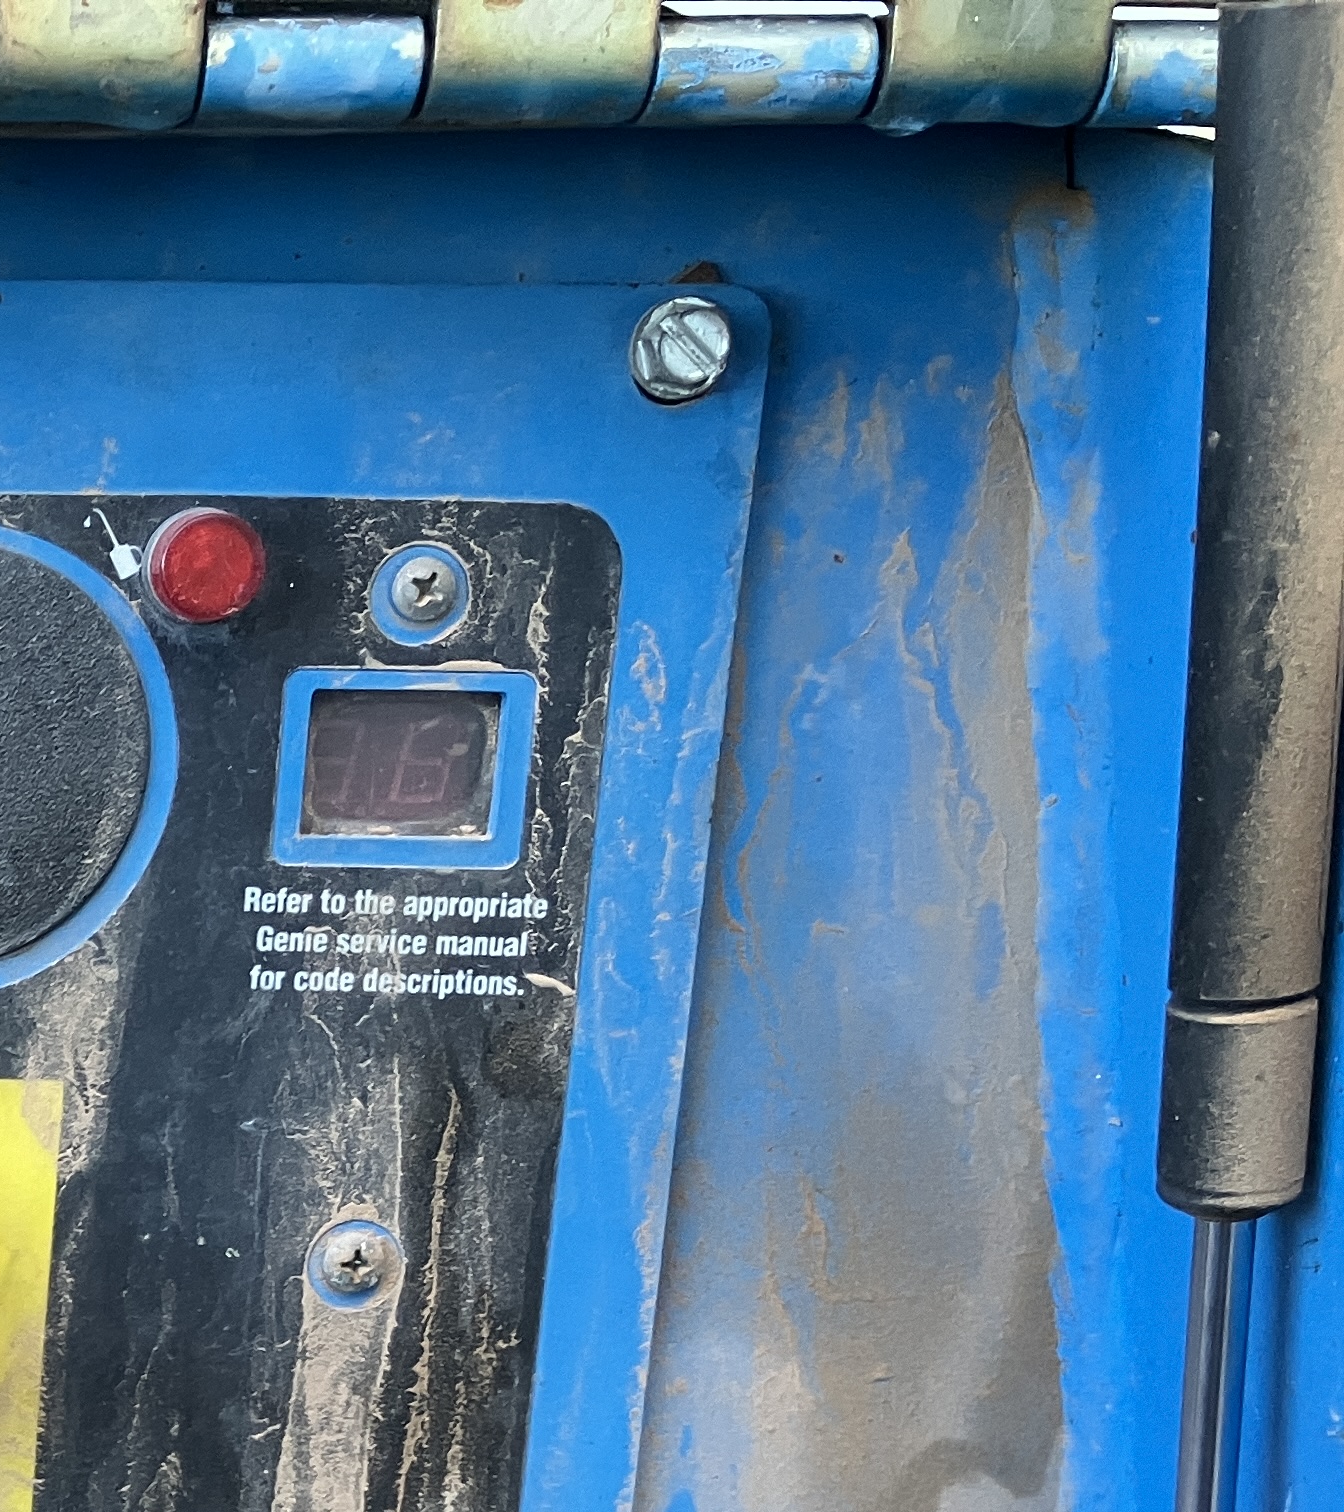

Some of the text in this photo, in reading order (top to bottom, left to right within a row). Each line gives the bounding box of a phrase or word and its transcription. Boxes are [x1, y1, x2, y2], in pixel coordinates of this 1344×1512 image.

[243, 886, 549, 923] Refer to the appropriate
[256, 925, 529, 957] Genie service manual
[249, 966, 526, 1000] for code descriptions.
